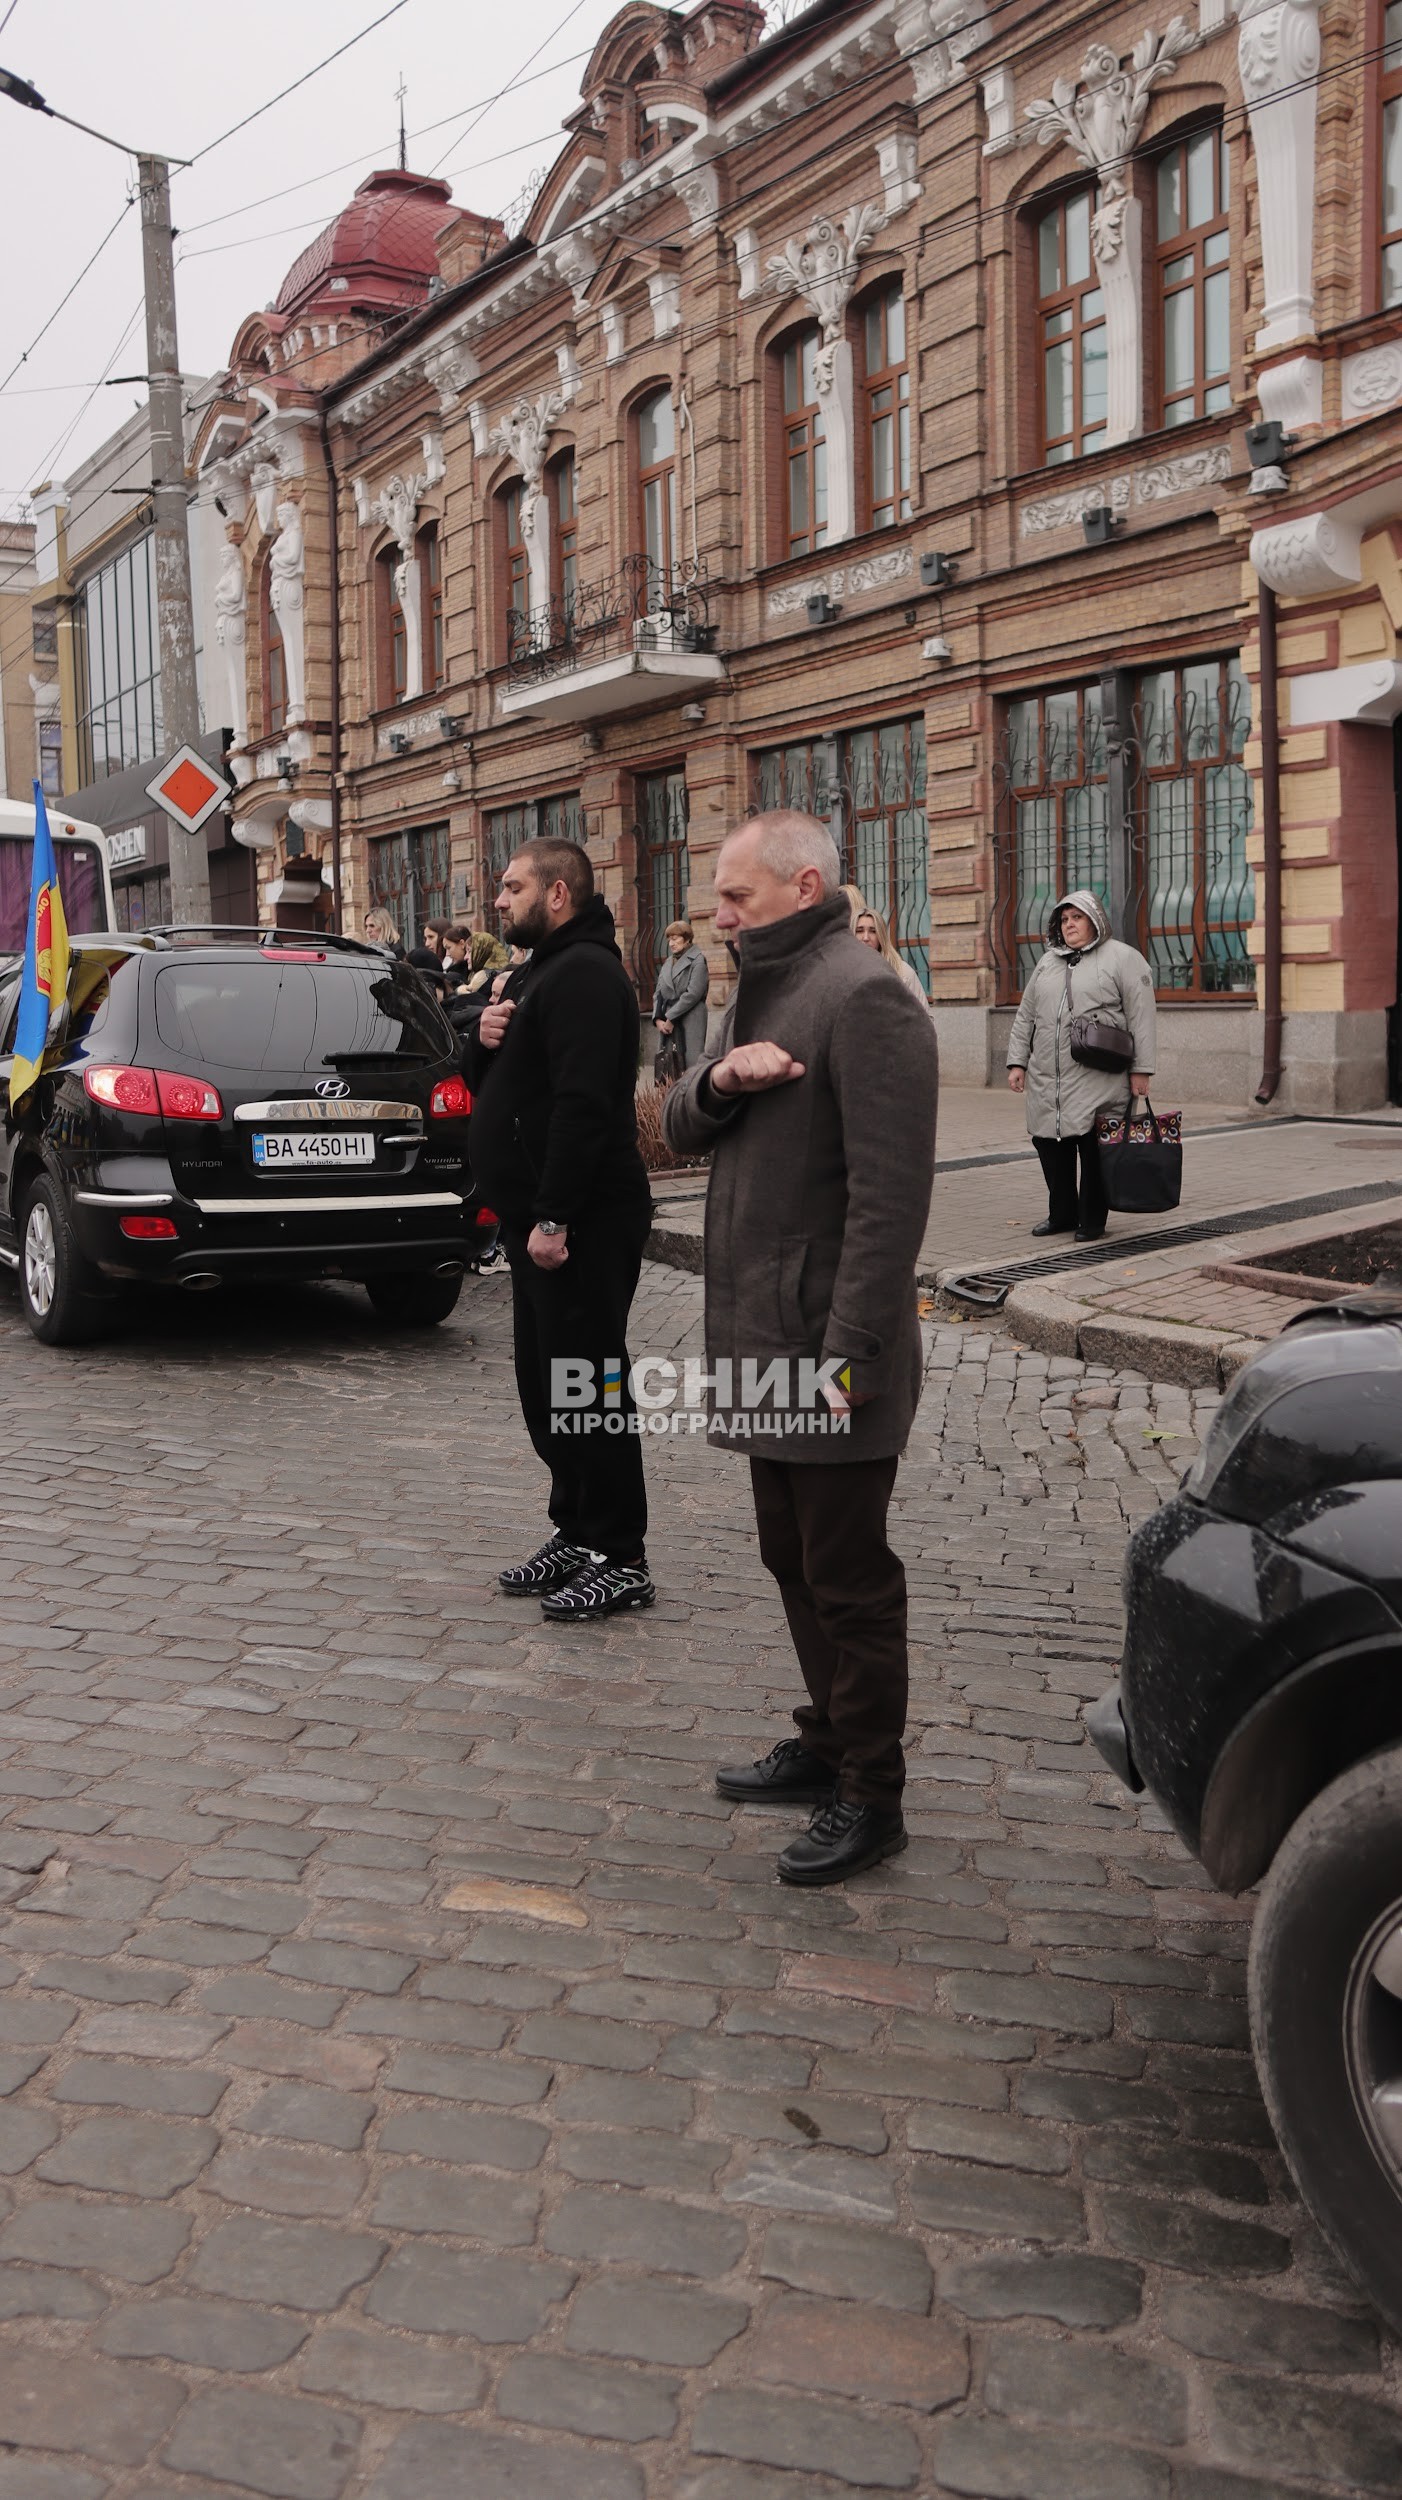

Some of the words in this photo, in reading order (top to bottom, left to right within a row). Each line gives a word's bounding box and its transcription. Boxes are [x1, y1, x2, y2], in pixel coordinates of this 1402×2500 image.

[106, 825, 146, 864] OSHEN
[266, 1138, 294, 1158] BA
[298, 1137, 341, 1157] 4450
[255, 1151, 265, 1159] UA
[181, 1160, 223, 1168] HYUNDAI
